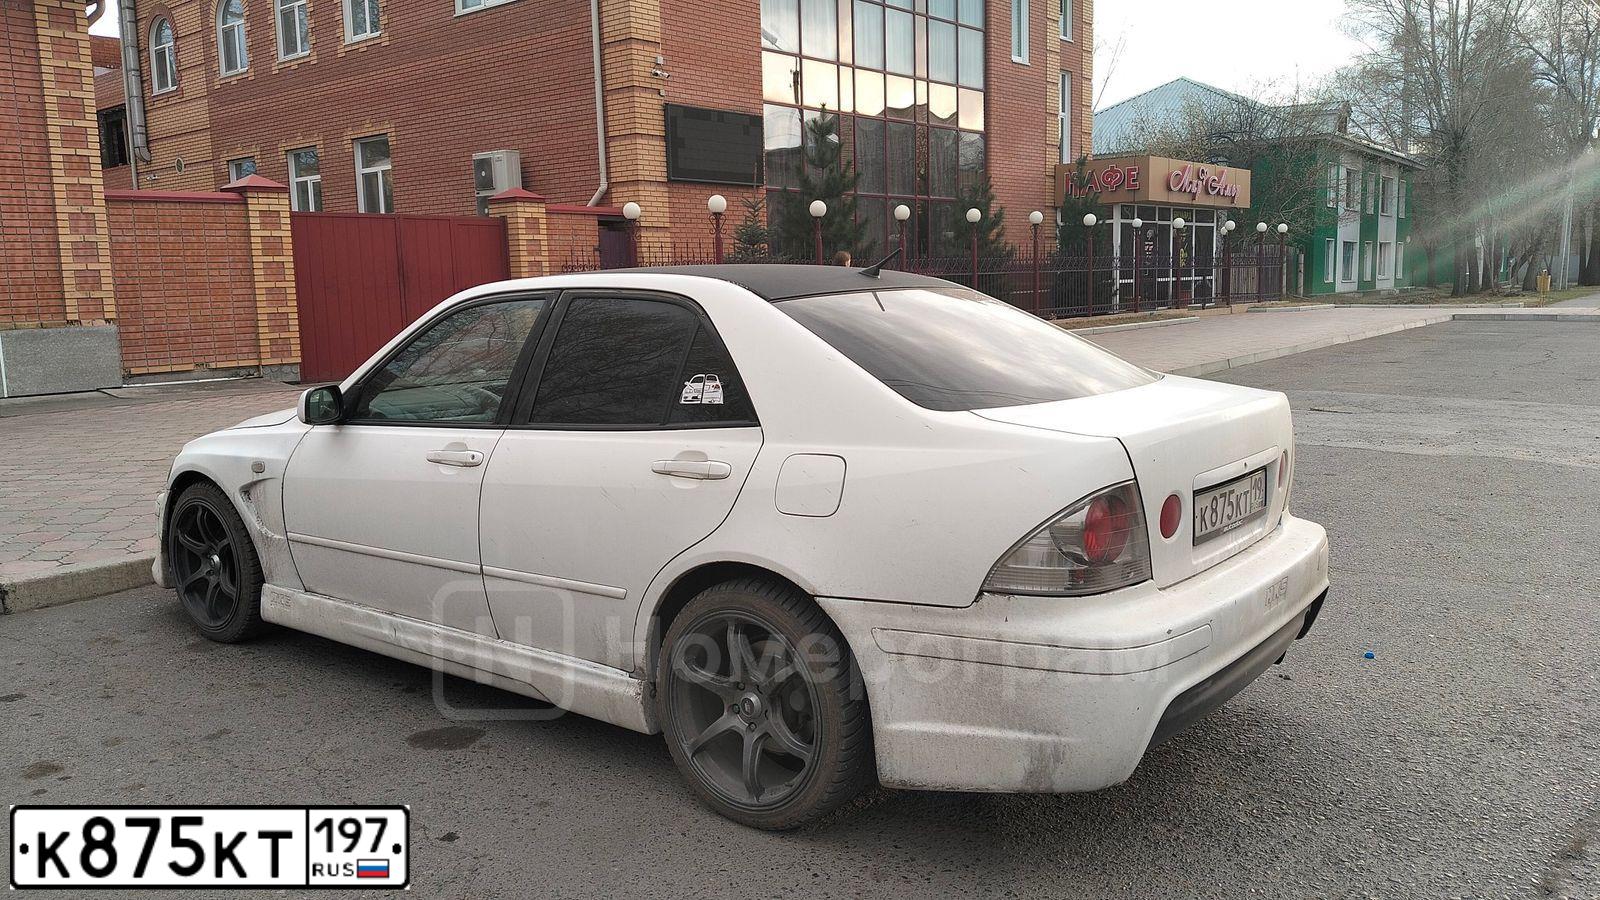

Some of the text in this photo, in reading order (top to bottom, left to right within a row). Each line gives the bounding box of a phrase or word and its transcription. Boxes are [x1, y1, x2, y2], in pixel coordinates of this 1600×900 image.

[1064, 165, 1140, 198] КАФЕ
[1200, 489, 1250, 532] К875КТ
[1252, 477, 1263, 501] 19
